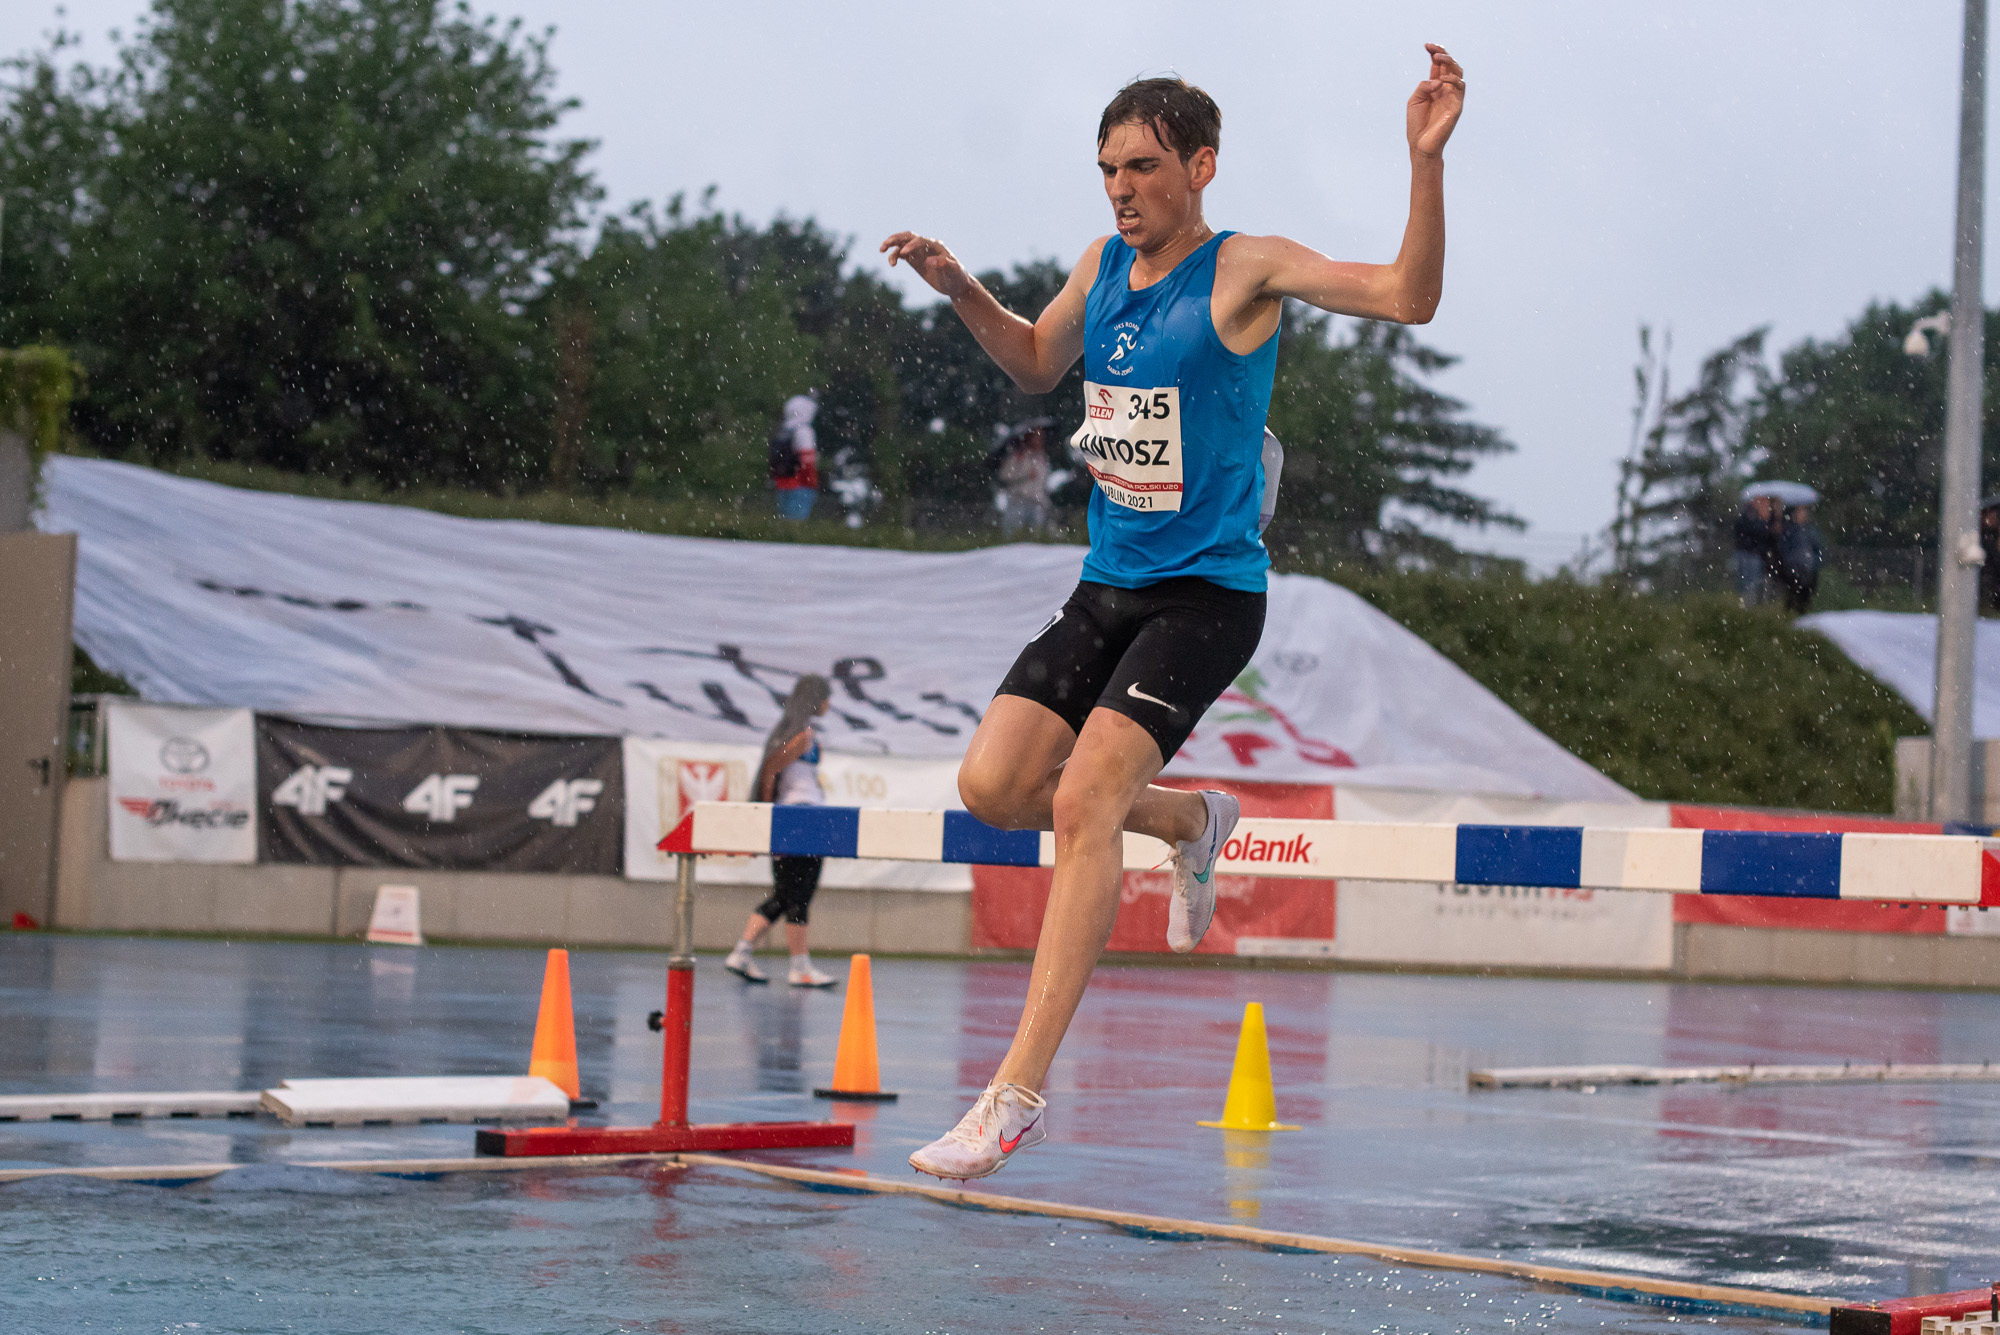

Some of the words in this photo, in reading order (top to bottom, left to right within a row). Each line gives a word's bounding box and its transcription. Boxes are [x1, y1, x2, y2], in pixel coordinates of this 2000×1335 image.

[1090, 406, 1113, 419] RLEN
[1128, 393, 1171, 420] 345
[1079, 433, 1170, 467] ANTOSZ
[1100, 484, 1125, 504] UBLIN
[1127, 494, 1153, 509] 2021
[1134, 483, 1162, 491] POLSKI
[1162, 483, 1179, 491] U20
[272, 764, 354, 817] 4F
[403, 773, 480, 823] 4F
[528, 778, 603, 827] 4F
[1217, 831, 1313, 864] olanik
